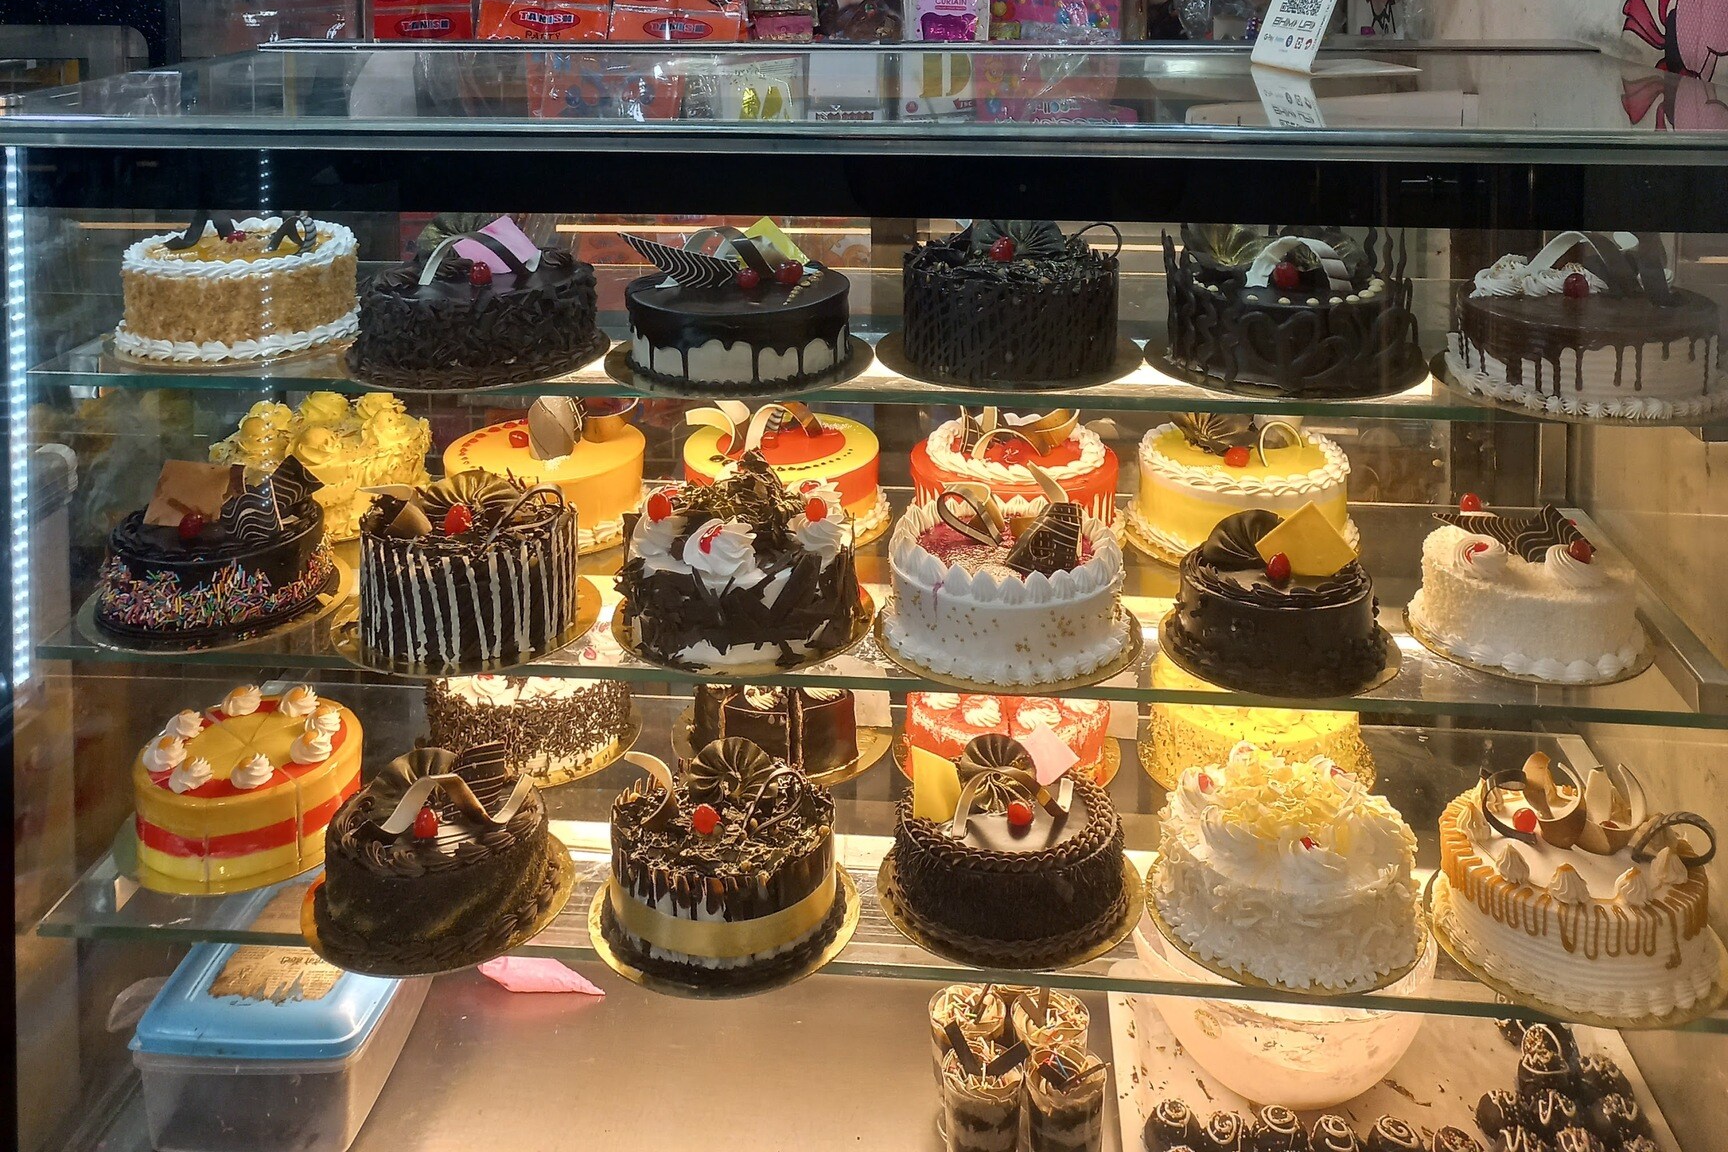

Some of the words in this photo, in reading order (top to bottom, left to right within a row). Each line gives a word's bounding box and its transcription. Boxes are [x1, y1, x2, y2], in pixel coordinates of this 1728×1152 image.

[518, 11, 575, 25] TANISH
[401, 19, 450, 32] TANISH
[525, 31, 561, 41] PARTY
